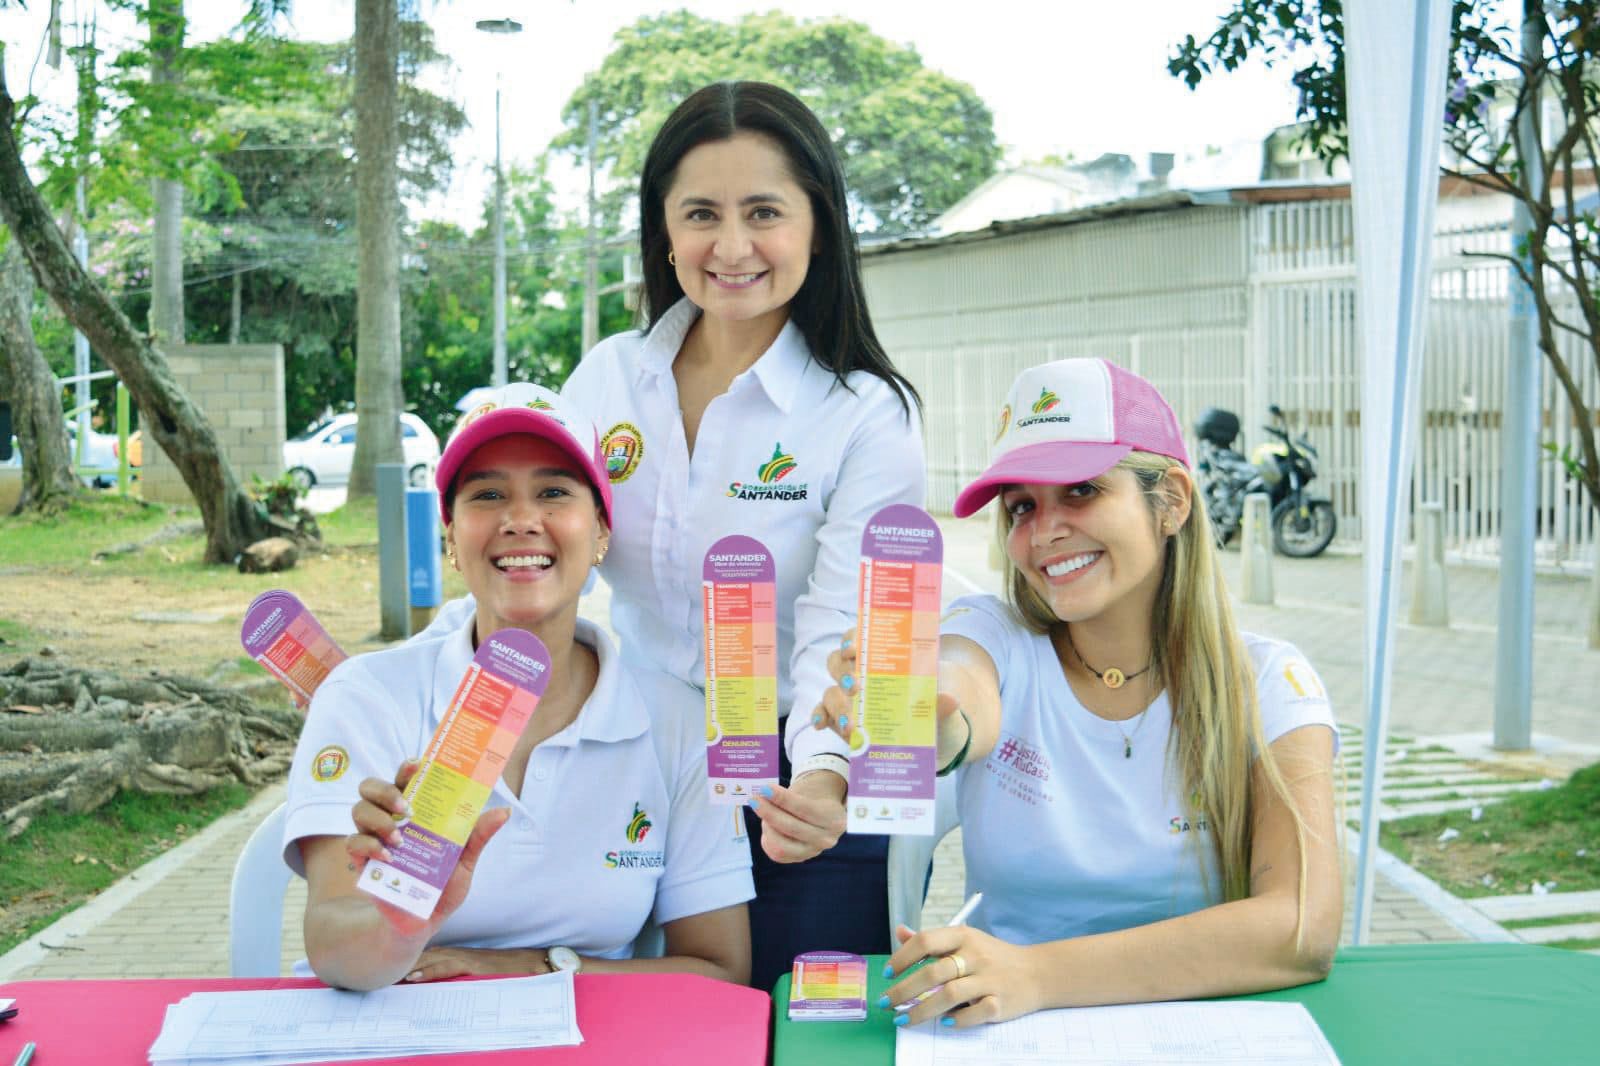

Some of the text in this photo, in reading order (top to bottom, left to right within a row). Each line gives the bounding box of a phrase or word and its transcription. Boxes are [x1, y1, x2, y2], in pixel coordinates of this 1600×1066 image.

[1016, 416, 1071, 430] SANTANDER
[726, 482, 808, 500] SANTANDER
[869, 525, 935, 538] SANTANDER
[709, 554, 767, 562] SANTANDER
[245, 607, 282, 646] SANTANDER
[489, 640, 546, 672] SANTANDER
